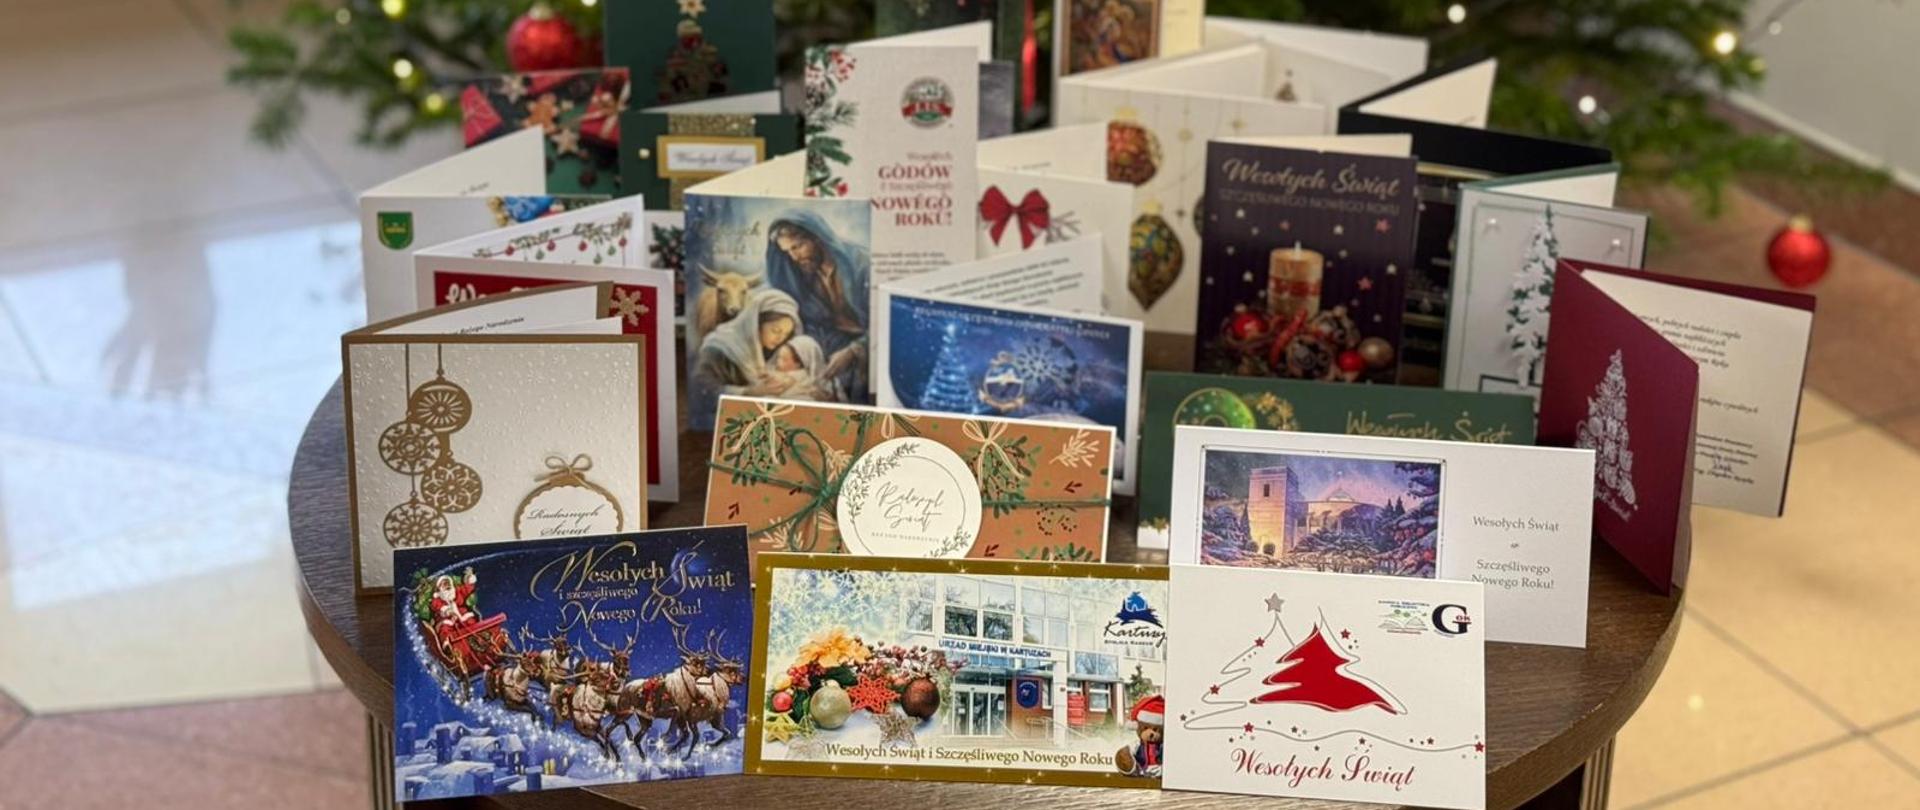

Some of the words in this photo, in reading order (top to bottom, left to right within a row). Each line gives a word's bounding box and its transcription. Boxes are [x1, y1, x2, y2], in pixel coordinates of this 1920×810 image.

[1222, 157, 1327, 194] Wesołych
[1332, 163, 1400, 201] Świąt
[526, 504, 605, 525] Radosnych
[1472, 516, 1526, 532] Wesołych
[1527, 517, 1560, 532] Świąt
[530, 541, 664, 601] Wesołych
[652, 540, 736, 598] Świąt
[1477, 559, 1551, 575] Szczęśliwego
[566, 585, 639, 601] szczęśliwego
[1472, 573, 1518, 590] Nowego
[1521, 577, 1554, 589] Roku!
[556, 599, 636, 632] Nowego
[641, 595, 702, 627] Roku!
[1104, 620, 1168, 648] Kartuzy
[938, 640, 967, 651] URZĄD
[968, 644, 999, 654] MIEJSKI
[1009, 648, 1052, 659] KARTUZACH
[825, 743, 887, 760] Wesołych
[889, 744, 927, 762] Świąt
[928, 748, 933, 758] i
[935, 746, 1019, 764] Szczęśliwego
[1022, 750, 1076, 768] Nowego
[1080, 753, 1113, 766] Roku
[1231, 747, 1334, 788] Wesołych
[1341, 744, 1415, 792] Świąt
